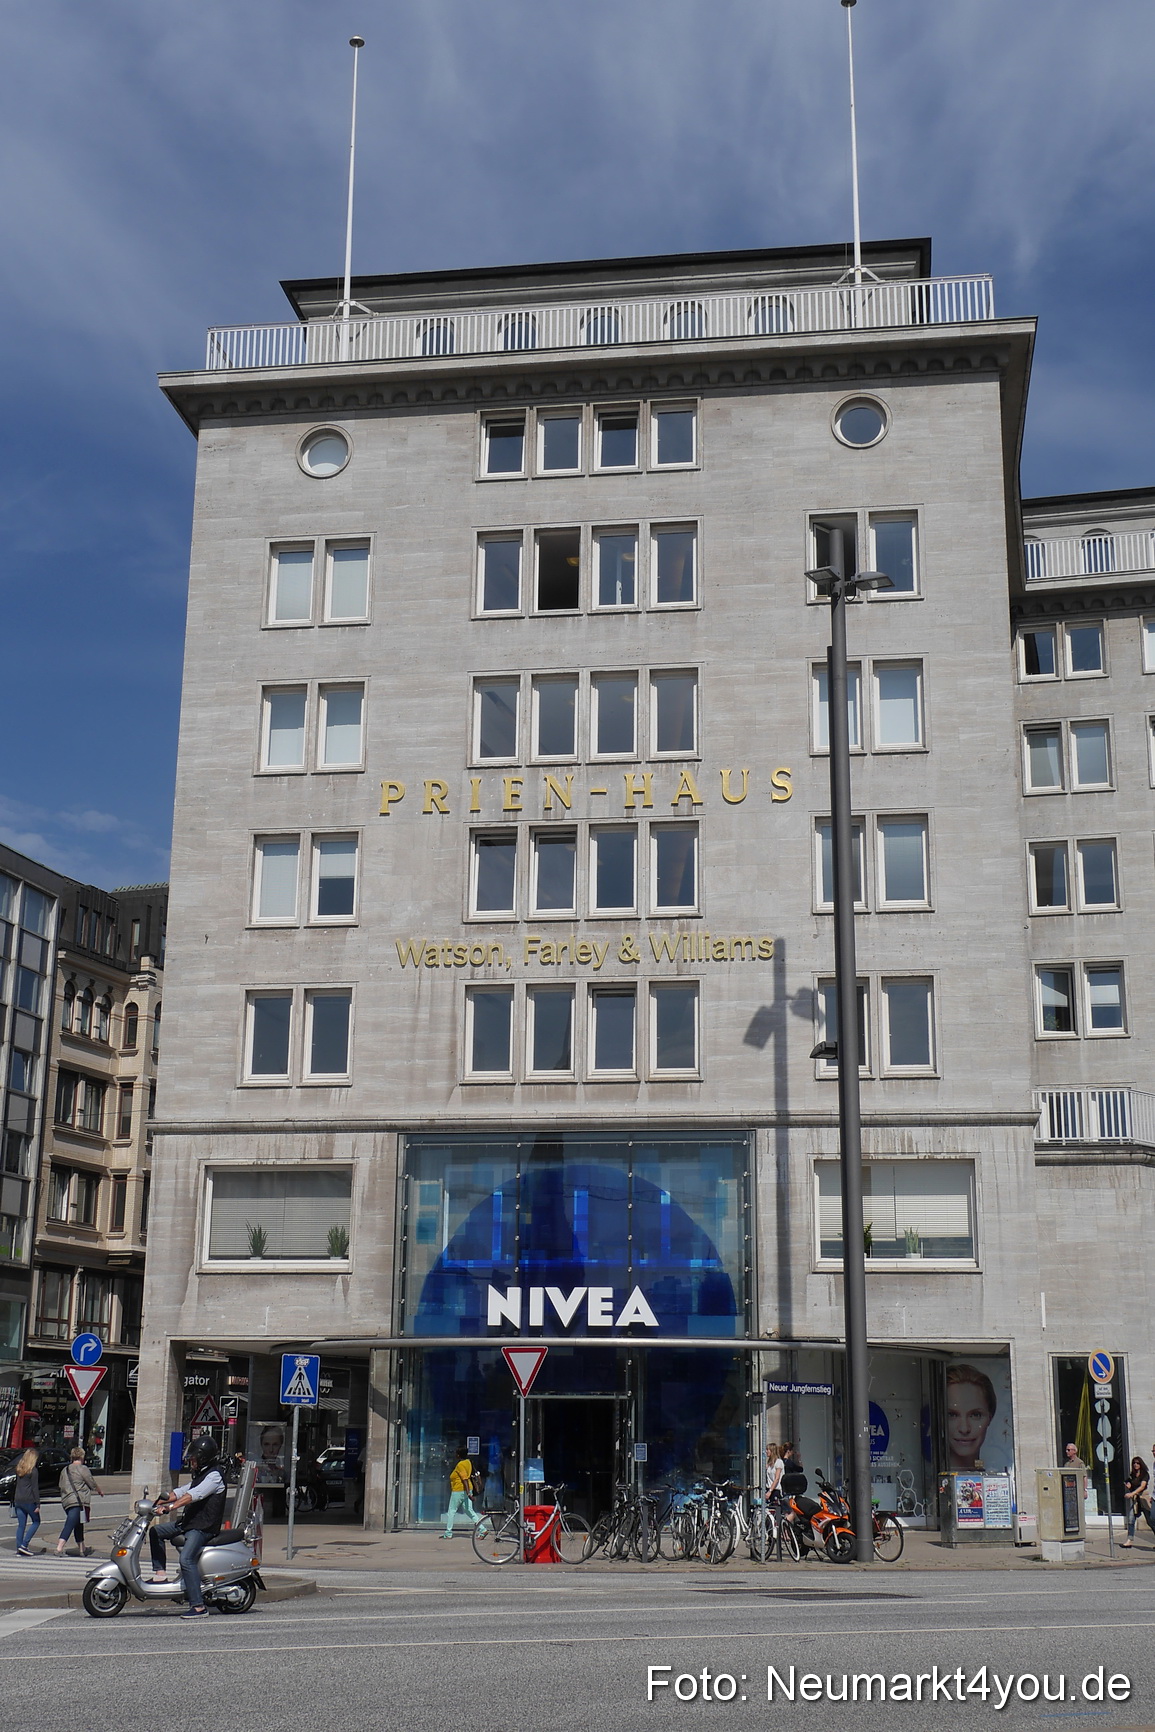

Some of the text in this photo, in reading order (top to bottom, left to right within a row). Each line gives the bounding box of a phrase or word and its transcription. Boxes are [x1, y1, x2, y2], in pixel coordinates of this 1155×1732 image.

[379, 767, 794, 816] PRIEN-HAUS
[395, 932, 774, 970] Watson, Farley & Williams
[487, 1283, 660, 1329] NIVEA
[769, 1382, 832, 1396] Neuer Jungfernstieg
